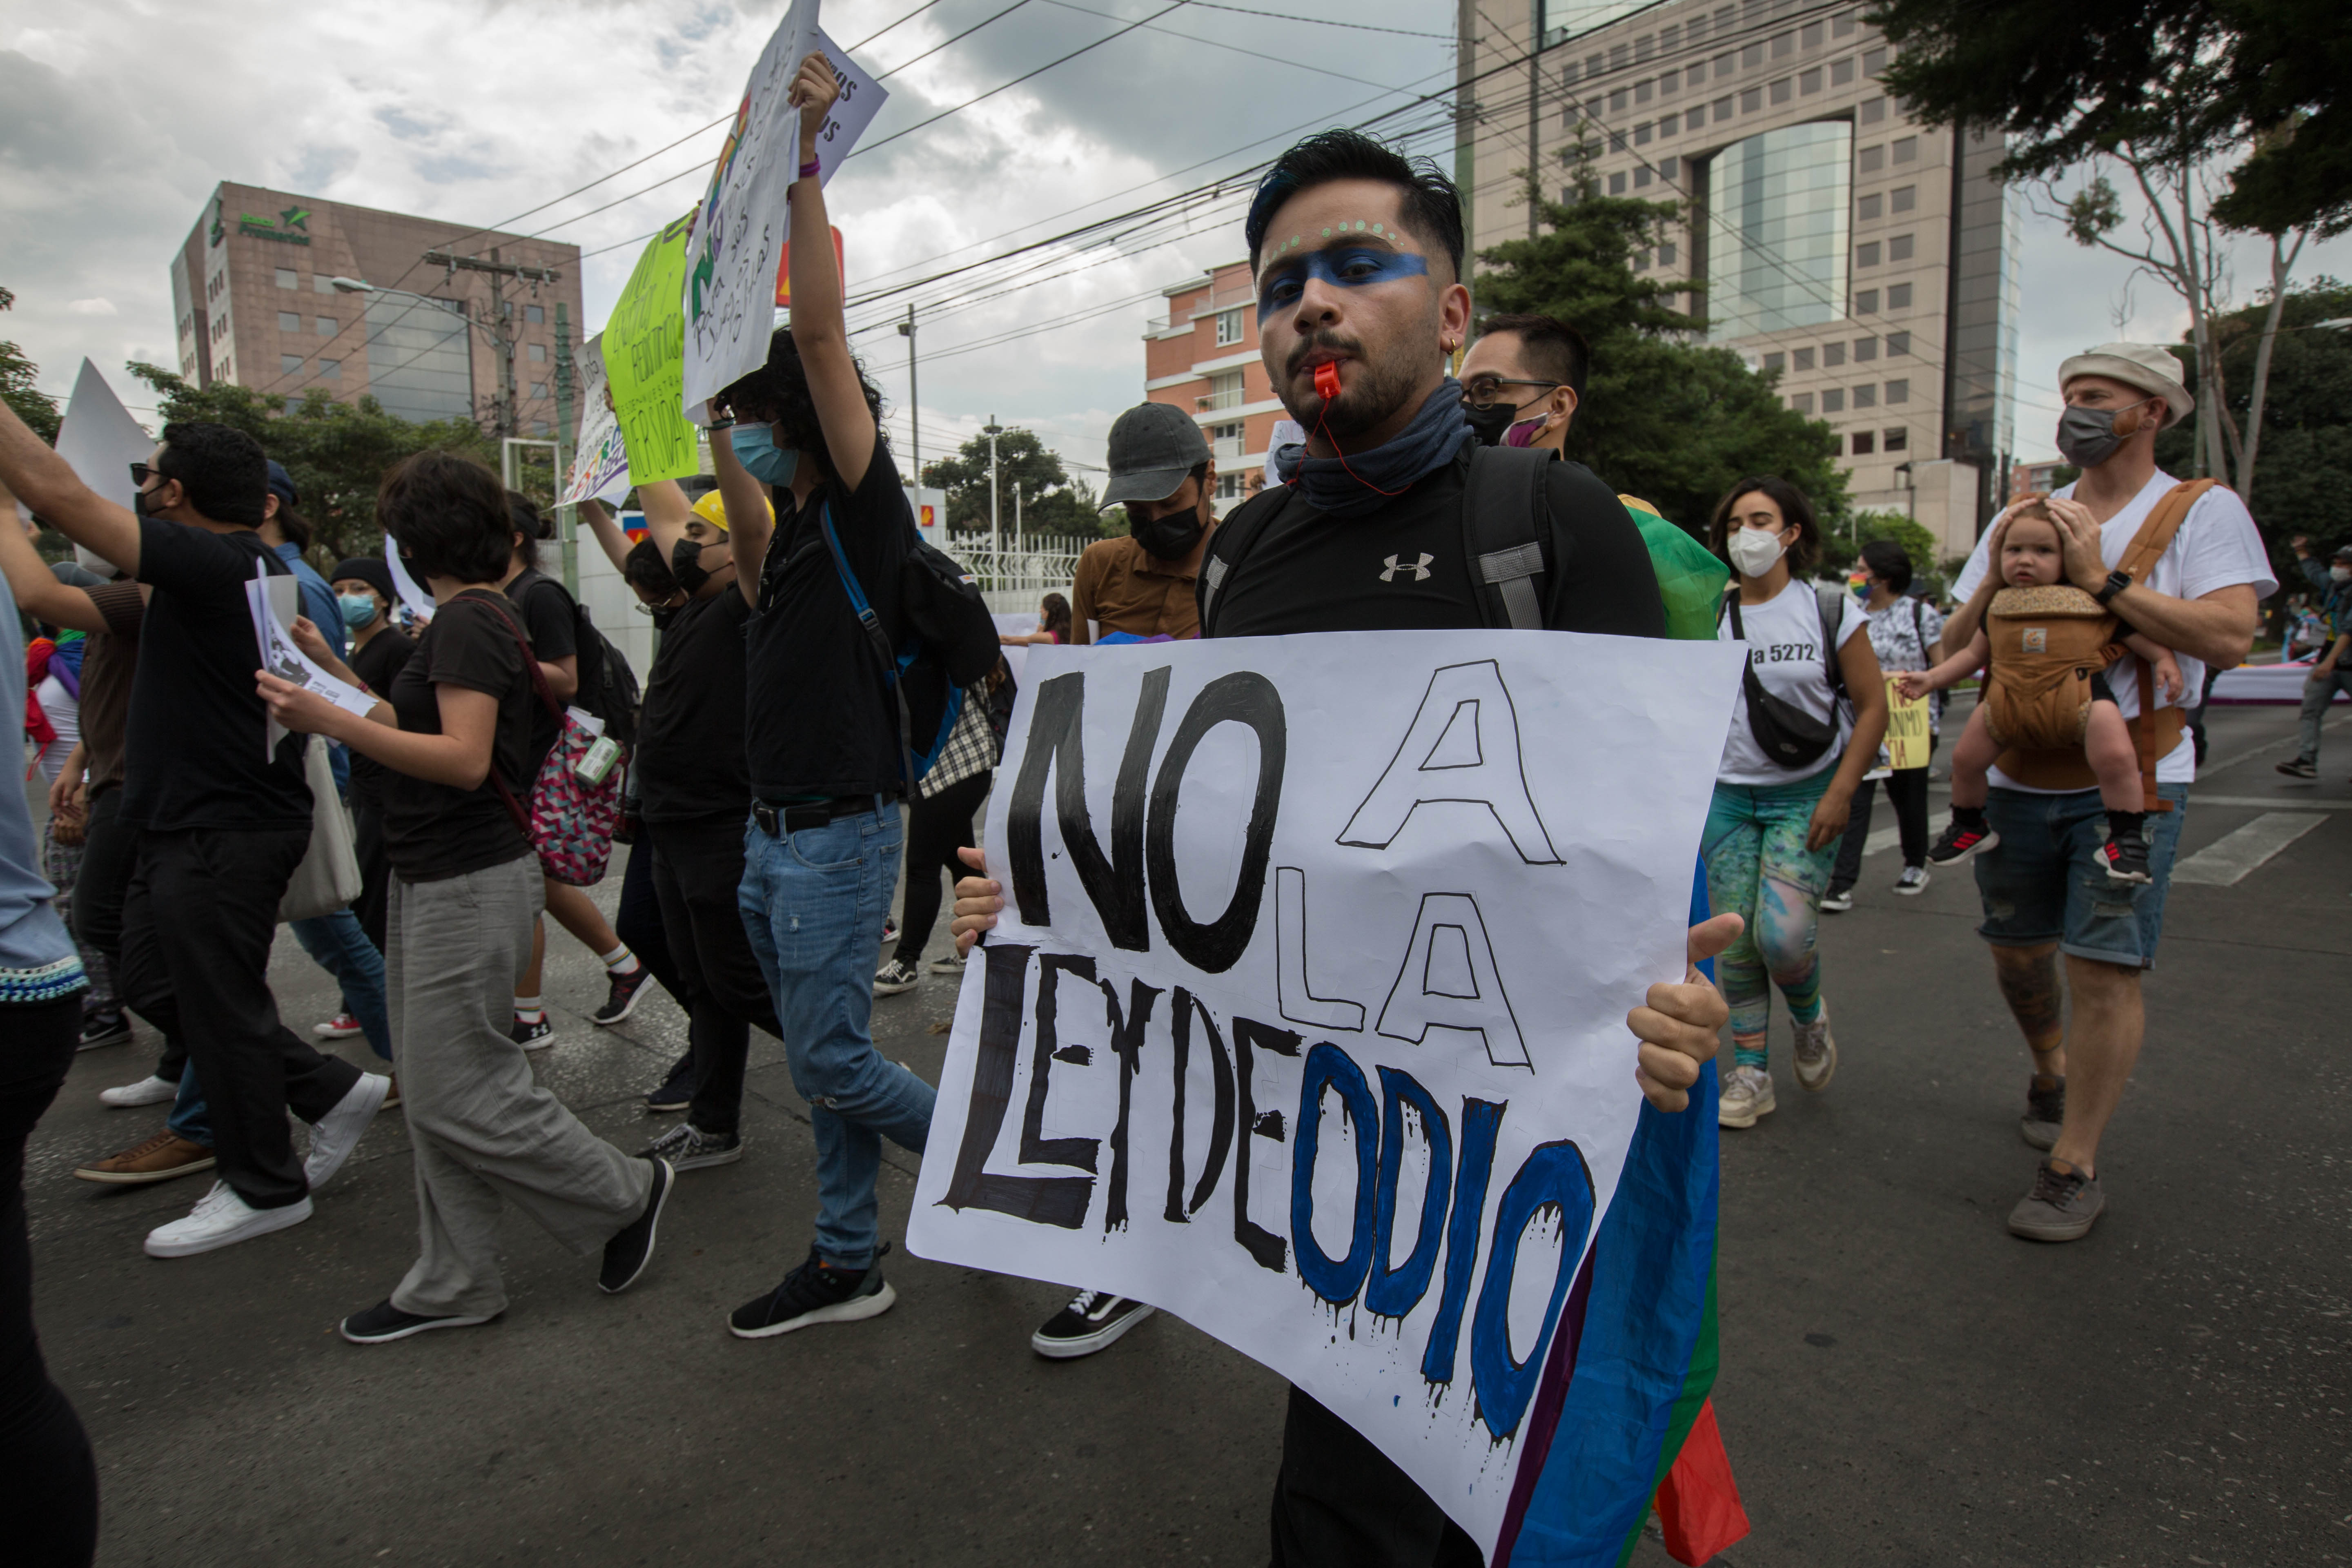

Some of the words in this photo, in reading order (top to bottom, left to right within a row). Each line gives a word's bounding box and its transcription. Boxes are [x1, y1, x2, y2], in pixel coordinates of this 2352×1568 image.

[1770, 644, 1815, 662] 5272
[1007, 665, 1287, 974] NO
[1335, 658, 1567, 866] A
[1276, 866, 1535, 1075] LA
[933, 944, 1166, 1233] LEY
[1164, 985, 1303, 1274] DE
[1290, 1040, 1597, 1441] ODIO
